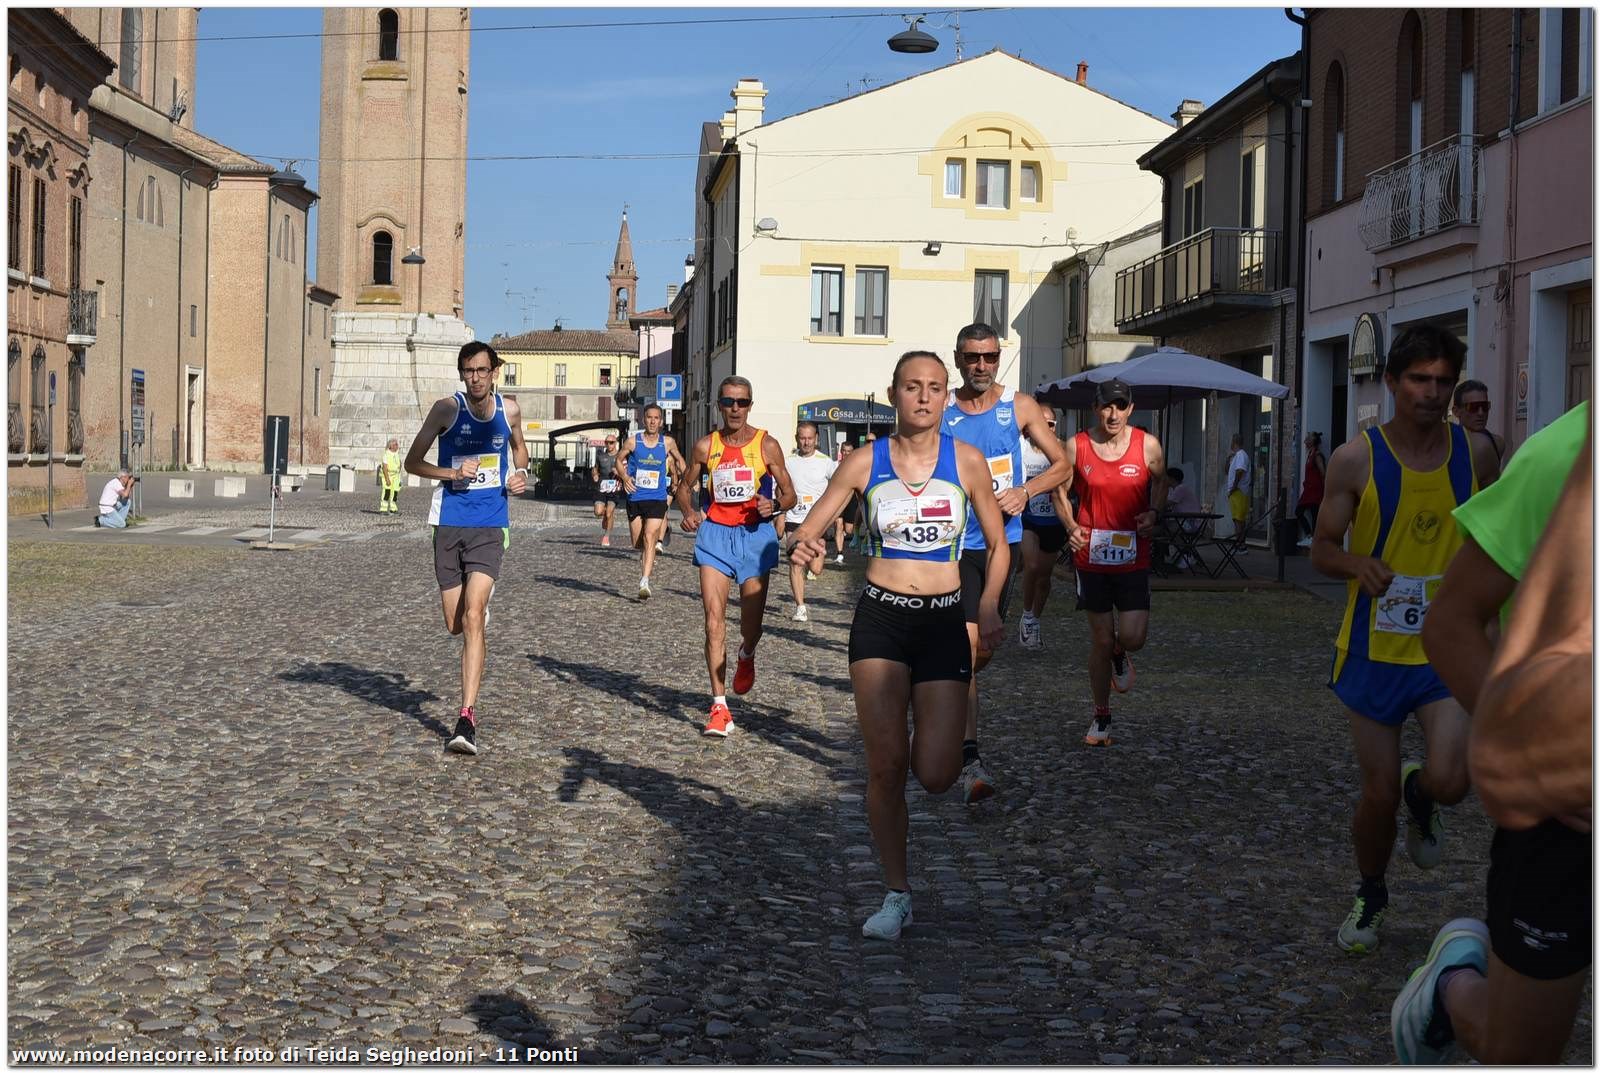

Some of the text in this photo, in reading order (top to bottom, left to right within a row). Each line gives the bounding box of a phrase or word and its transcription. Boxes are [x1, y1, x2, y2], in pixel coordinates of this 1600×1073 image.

[661, 377, 677, 398] P
[814, 406, 827, 417] La
[828, 407, 854, 421] Cassa
[723, 486, 745, 498] 162
[901, 525, 939, 544] 138
[1102, 548, 1125, 560] 111
[880, 592, 924, 609] PRO
